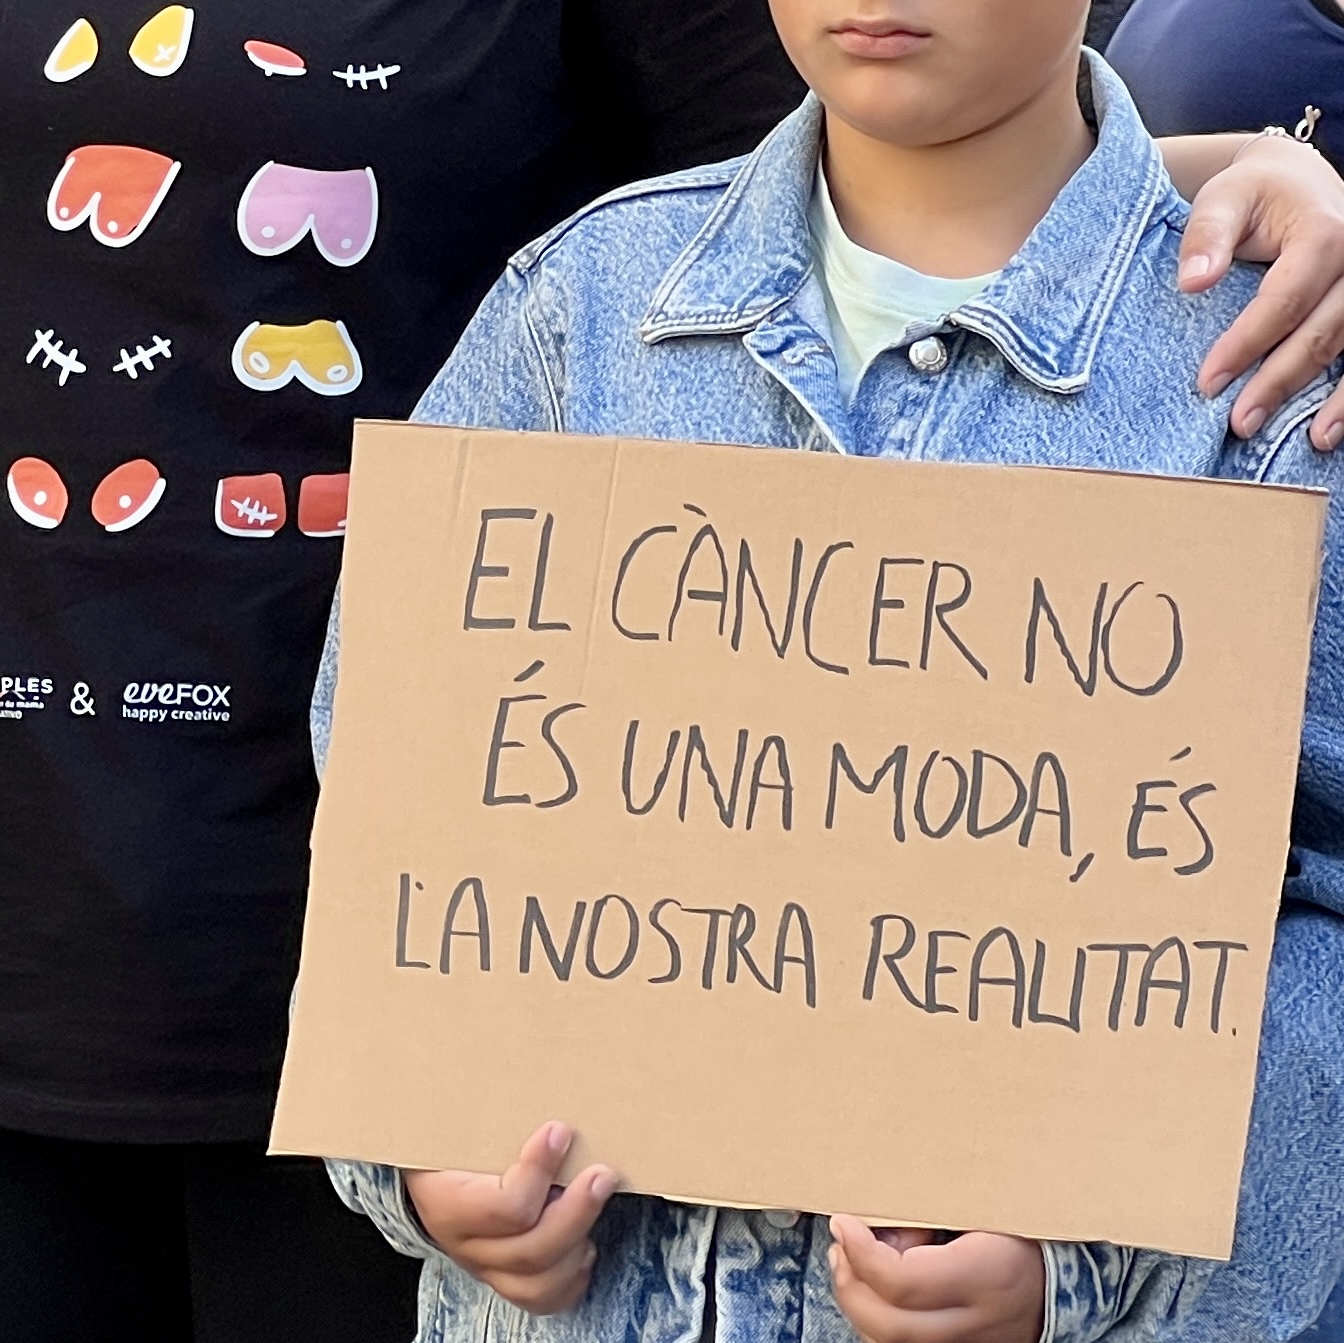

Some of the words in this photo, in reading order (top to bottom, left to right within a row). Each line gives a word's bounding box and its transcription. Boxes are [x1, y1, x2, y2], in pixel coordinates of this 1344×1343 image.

[463, 508, 571, 631] EL
[612, 504, 988, 680] CÀNCER
[1024, 577, 1183, 697] NO
[70, 681, 96, 716] &
[122, 705, 167, 722] happy
[171, 707, 231, 722] creative
[483, 660, 586, 808] ÉS
[622, 720, 793, 831] UNA
[825, 742, 1095, 883] MODA,
[1127, 746, 1217, 876] ÉS
[519, 894, 816, 1008] NOSTRA
